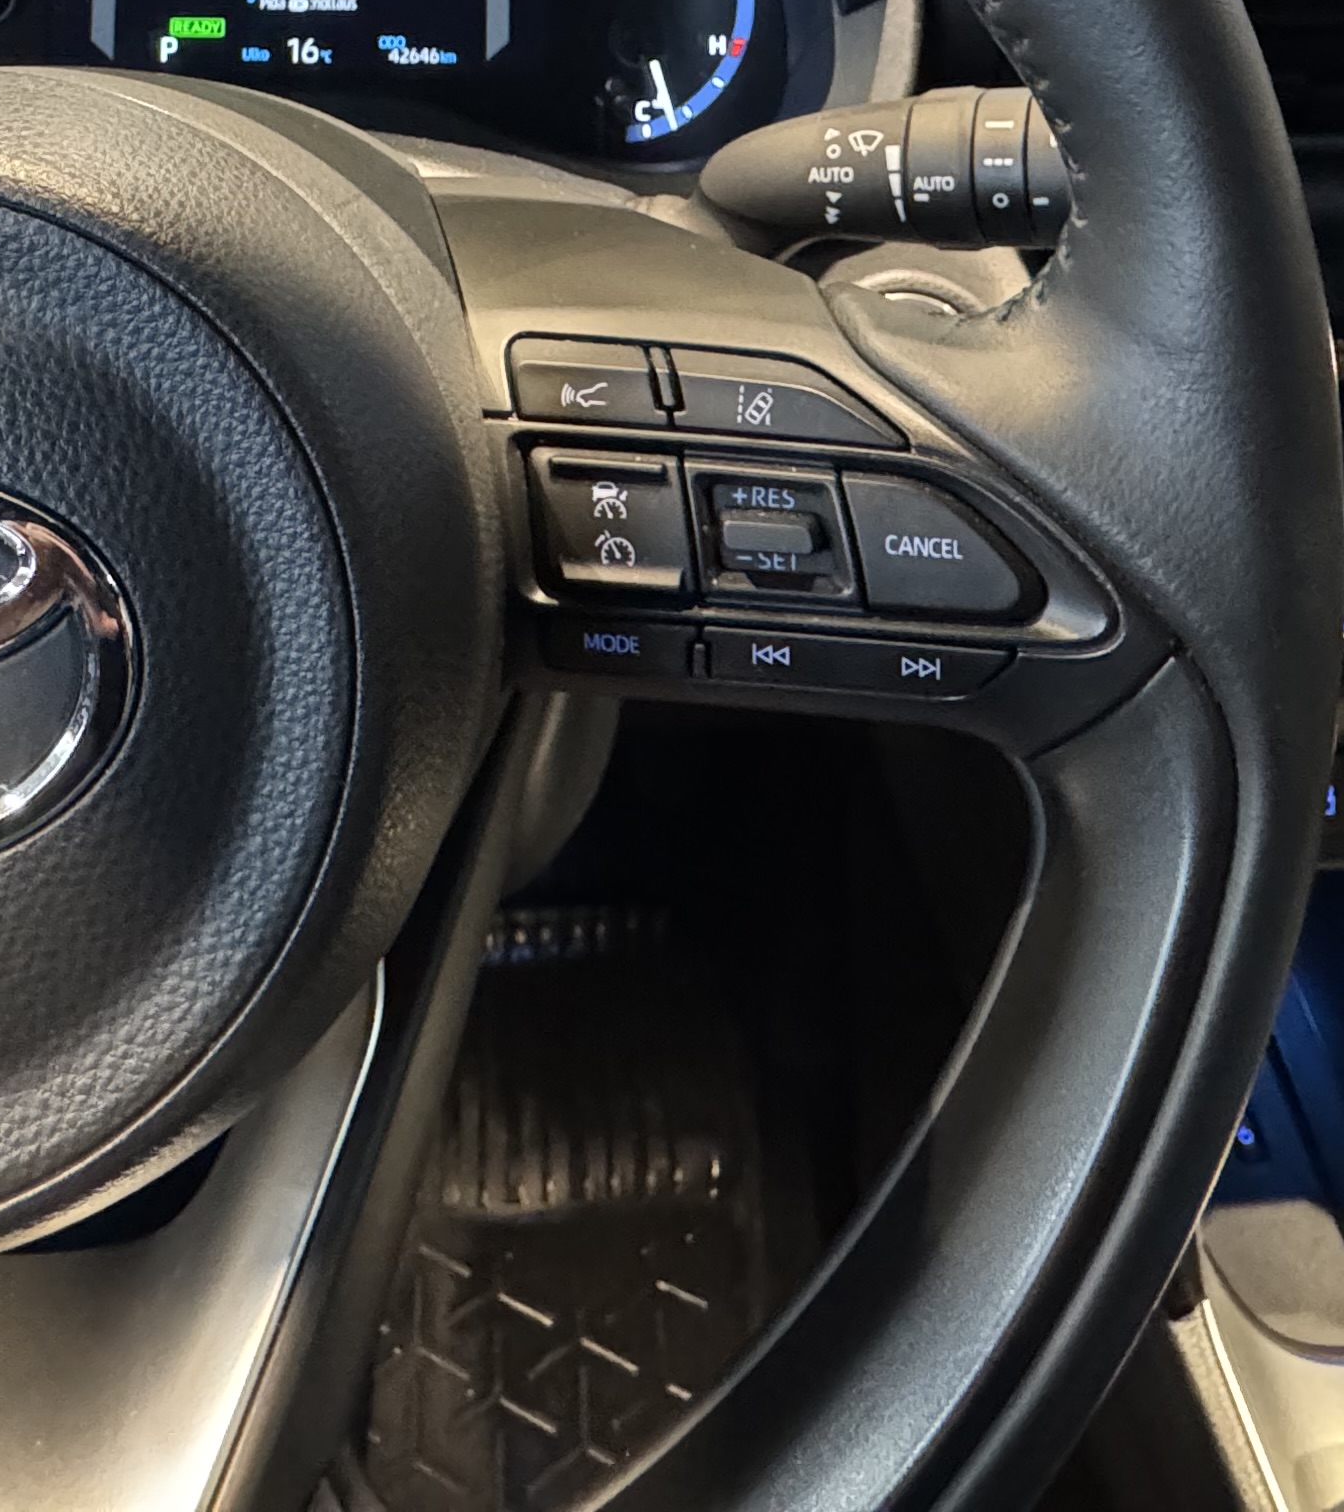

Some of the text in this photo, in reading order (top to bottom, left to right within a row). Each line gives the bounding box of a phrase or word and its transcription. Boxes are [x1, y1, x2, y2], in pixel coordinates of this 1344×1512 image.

[173, 19, 223, 35] READY
[160, 36, 179, 64] P
[378, 35, 406, 50] ODO
[709, 35, 727, 56] H
[634, 100, 652, 122] C
[808, 165, 855, 184] AUTO
[913, 175, 956, 192] AUTO
[884, 533, 963, 560] CANCEL
[583, 632, 640, 655] MODE
